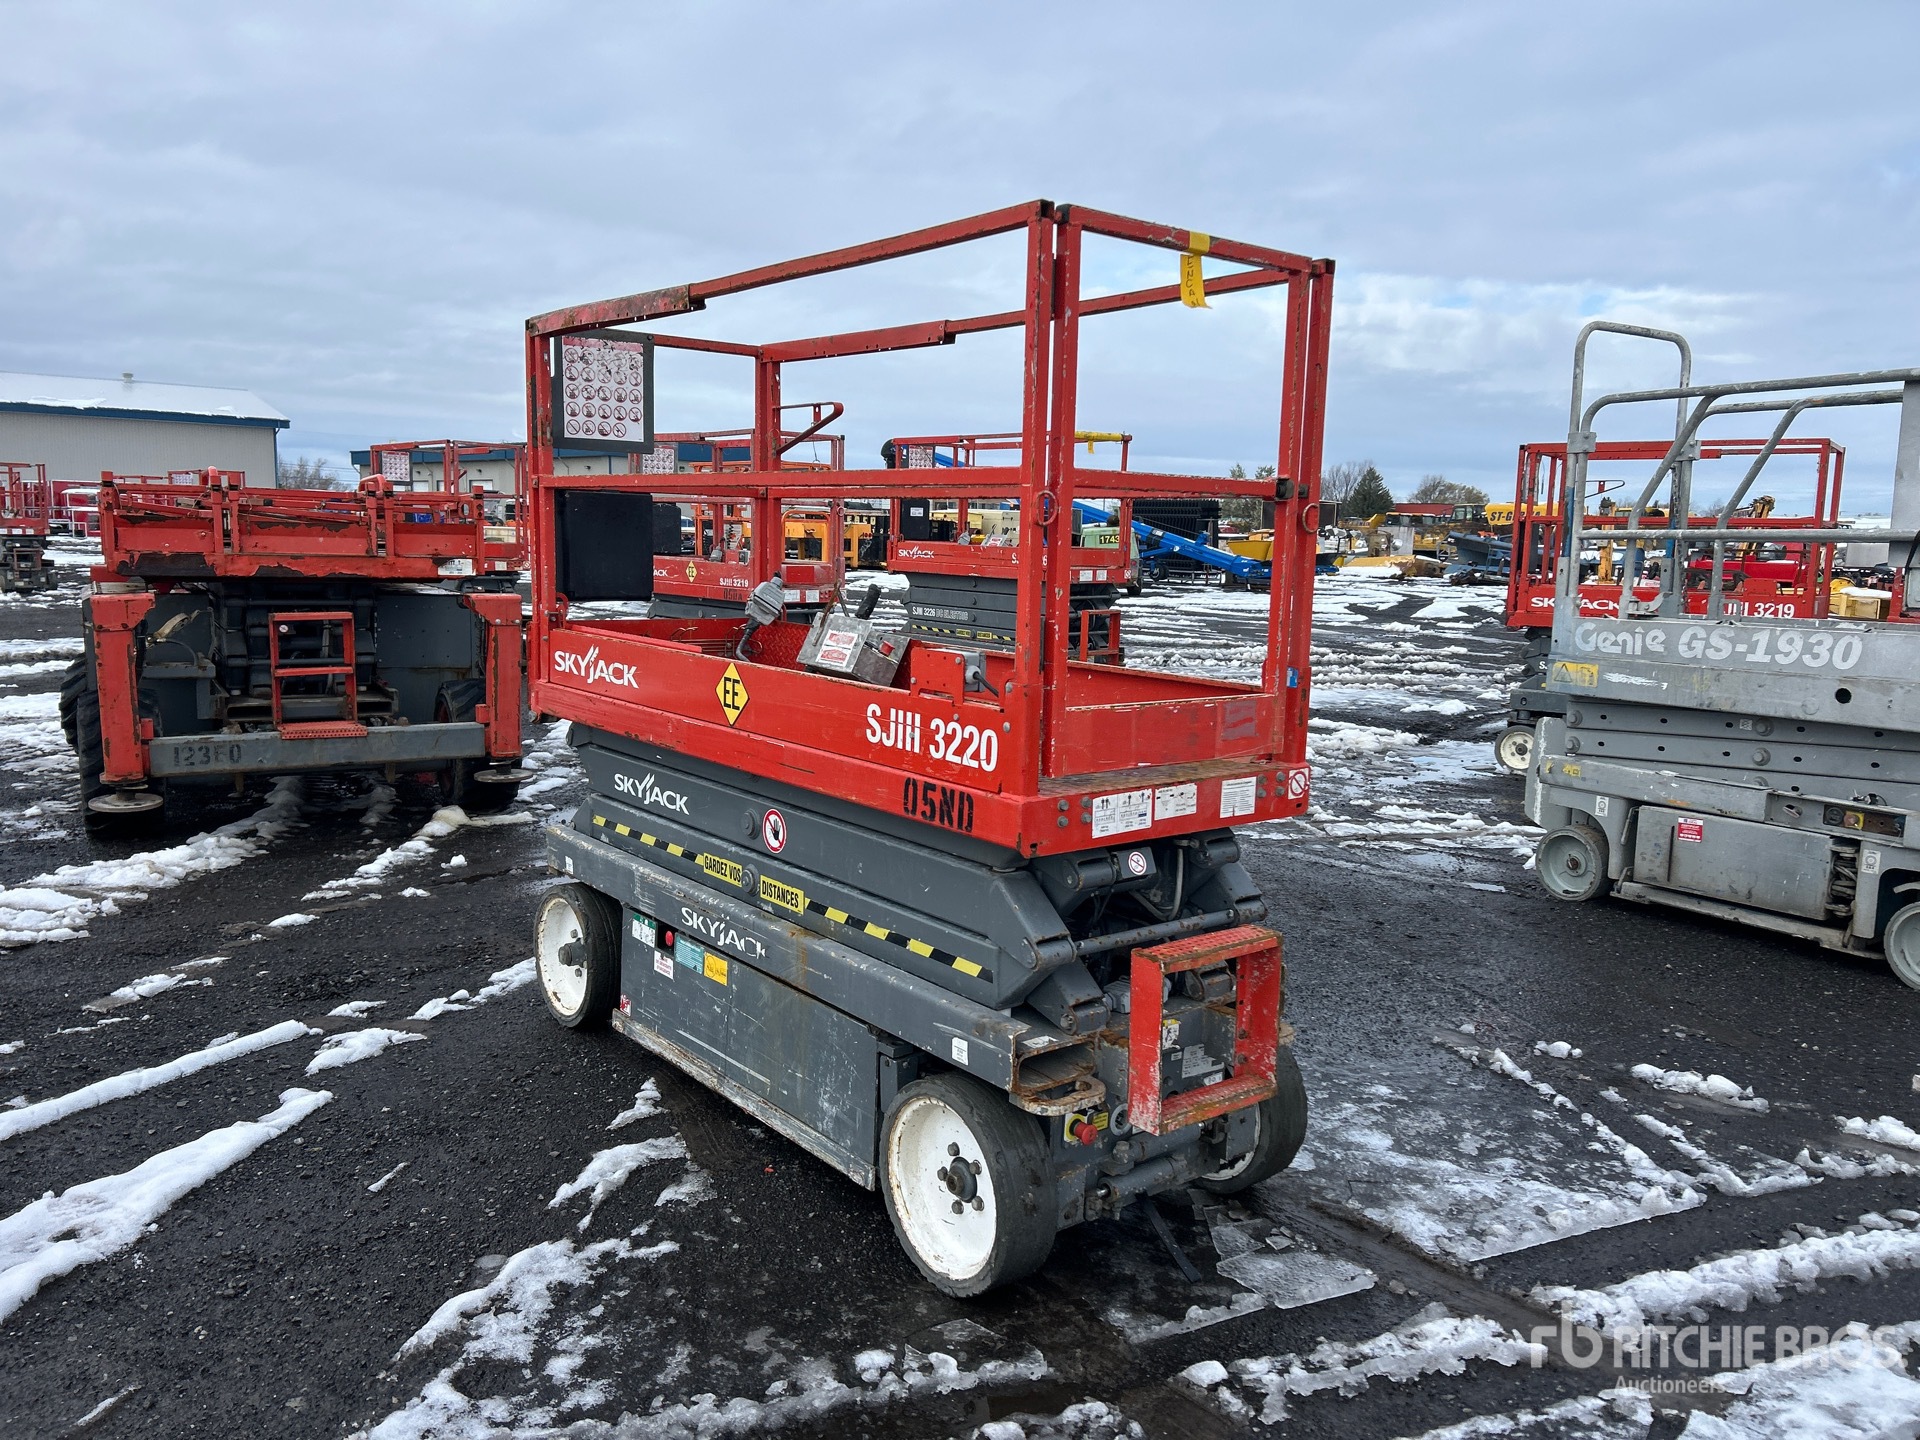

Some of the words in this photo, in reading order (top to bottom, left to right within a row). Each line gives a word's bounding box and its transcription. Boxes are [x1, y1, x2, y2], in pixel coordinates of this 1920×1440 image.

[898, 546, 935, 559] SKYJACK
[733, 579, 748, 588] 3219
[924, 607, 936, 617] 3226
[1530, 593, 1619, 611] SKACK
[1753, 602, 1795, 618] 3219
[1574, 622, 1667, 656] Genie
[1678, 626, 1863, 670] GS-1930
[554, 644, 639, 689] SKYJACK
[723, 676, 740, 711] EE
[929, 717, 998, 772] 3220
[614, 772, 690, 816] SKYJACK
[704, 855, 728, 878] GARDEZ
[728, 864, 742, 883] VOS
[761, 880, 799, 909] DISTANCES
